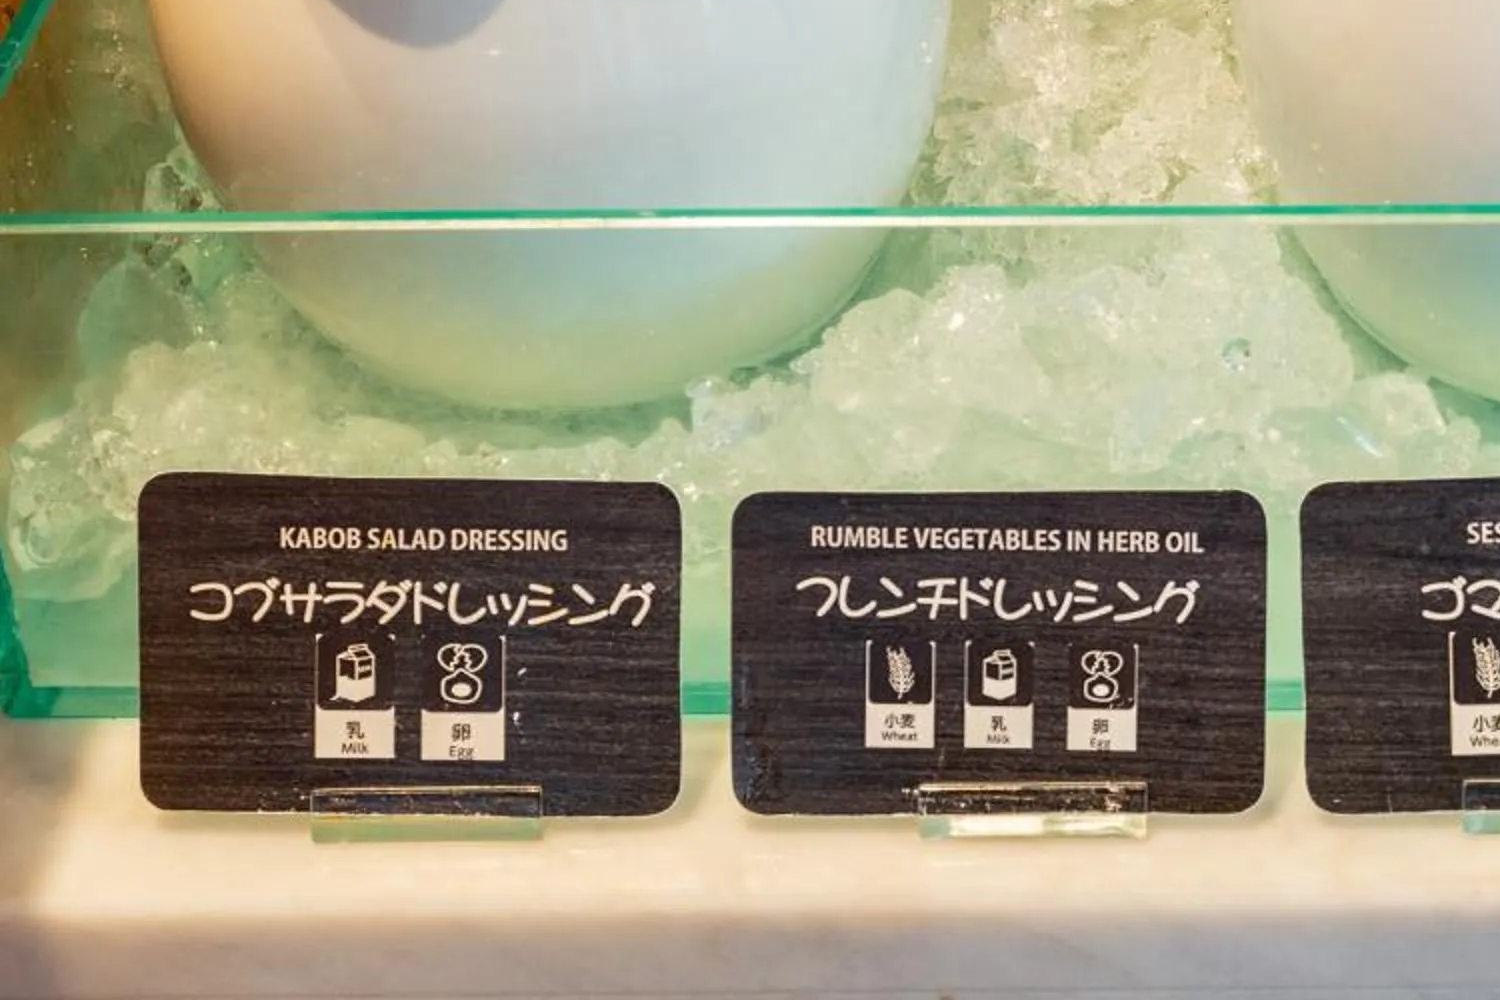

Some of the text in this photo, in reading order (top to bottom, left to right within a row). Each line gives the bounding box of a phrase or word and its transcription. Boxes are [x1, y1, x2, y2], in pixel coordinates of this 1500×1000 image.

[280, 527, 568, 551] KABOB SALAD DRESSING
[811, 525, 1205, 554] RUMBLE VEGETABLES IN HERB OIL
[190, 577, 656, 627] コブサラダドレッシング
[796, 575, 1201, 624] フレンチドレッシング
[346, 721, 365, 739] 乳
[884, 714, 915, 729] 小麦
[452, 723, 471, 741] 卵
[882, 731, 917, 742] Wheat
[341, 743, 368, 754] Milk
[449, 746, 474, 760] Egg
